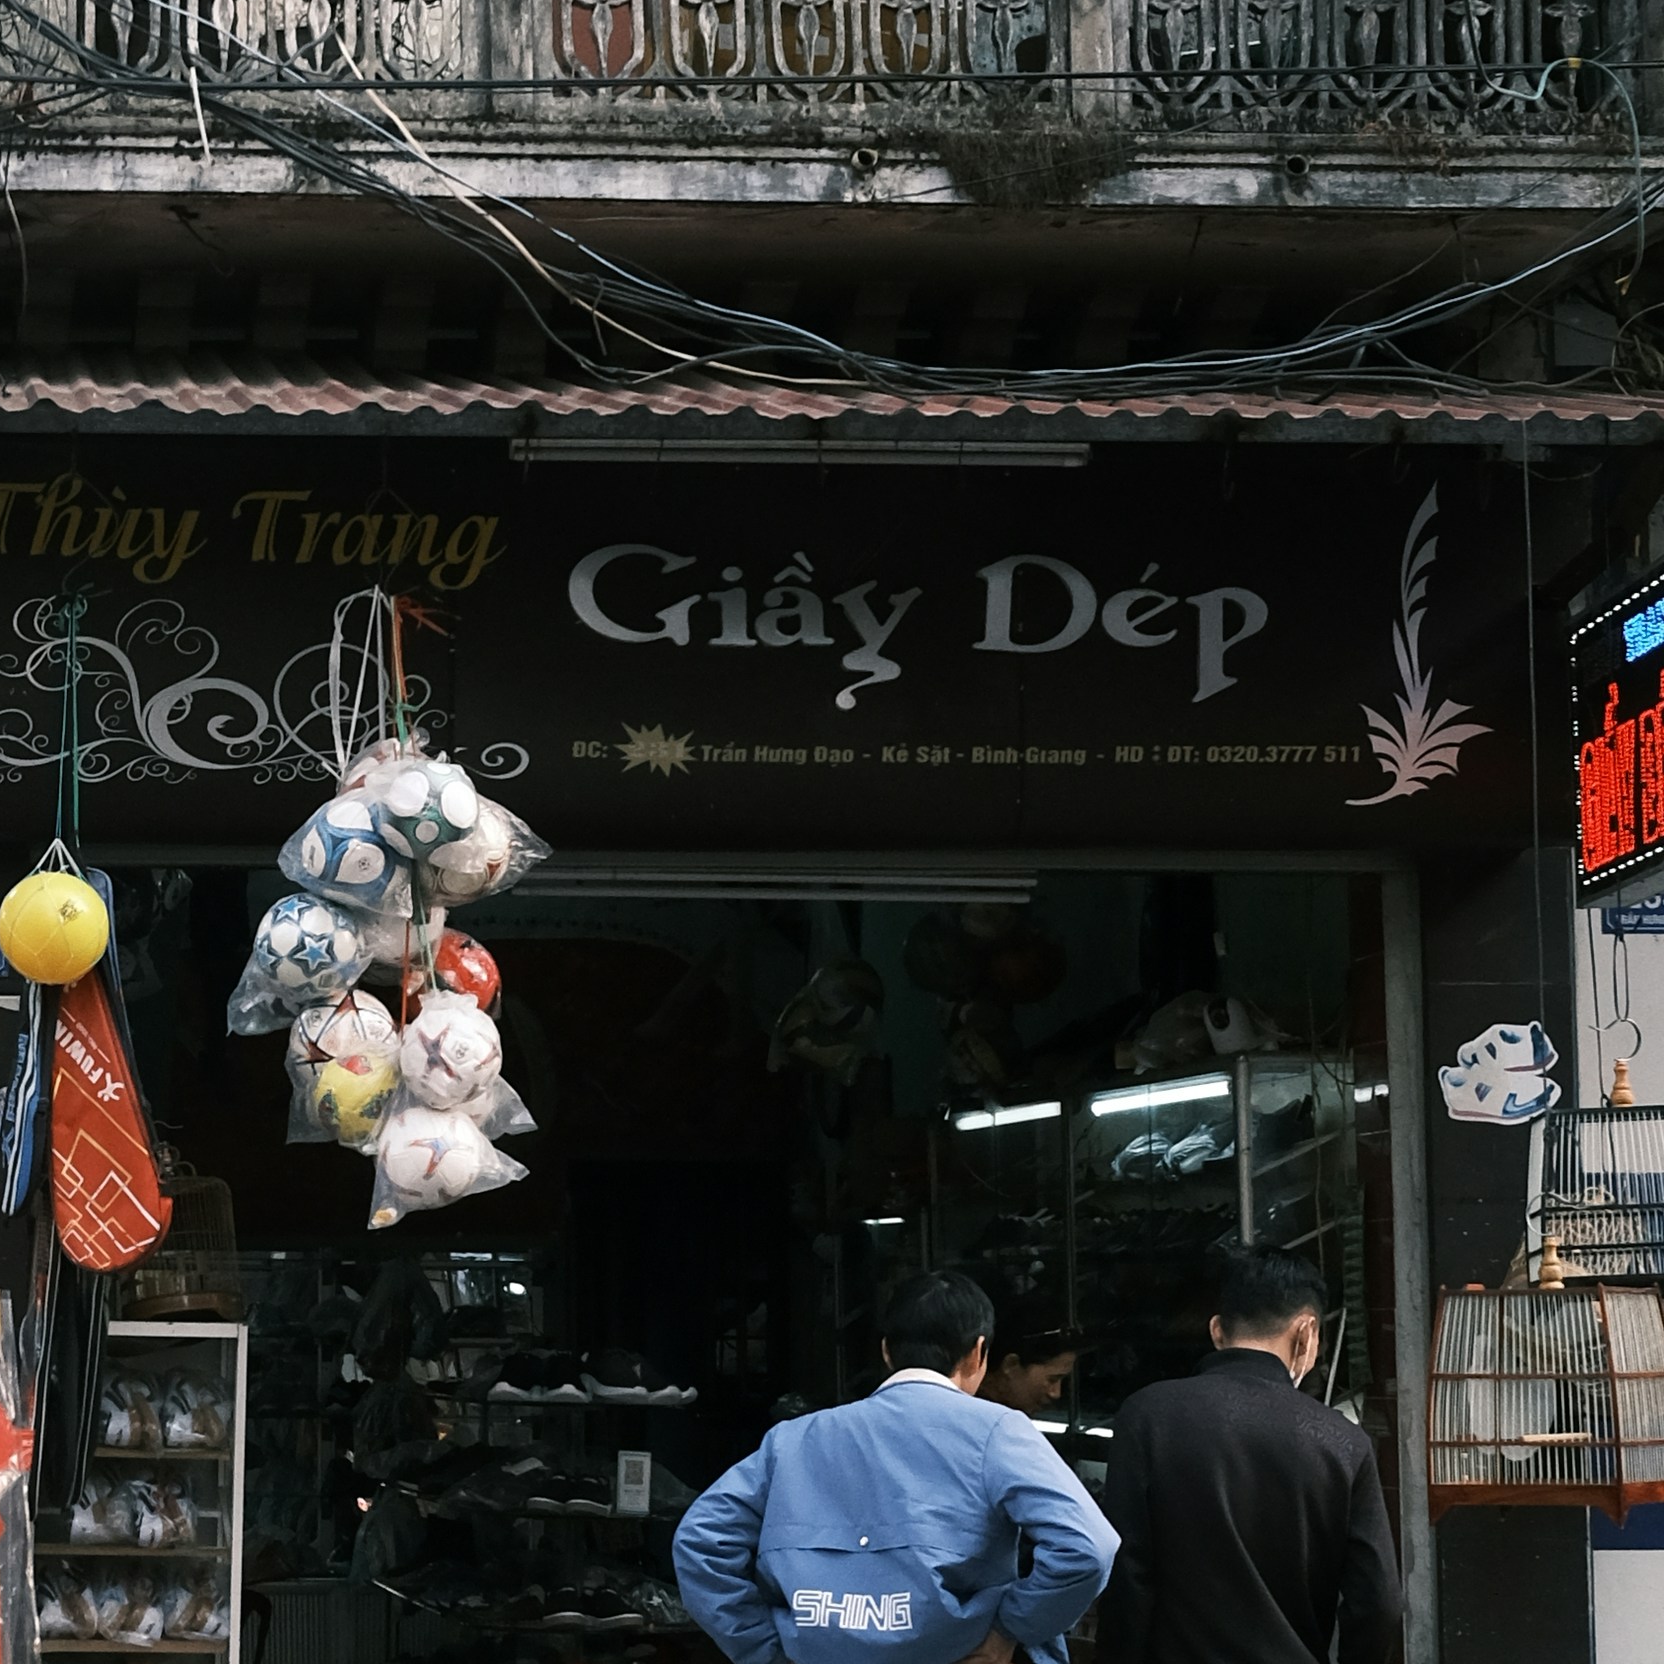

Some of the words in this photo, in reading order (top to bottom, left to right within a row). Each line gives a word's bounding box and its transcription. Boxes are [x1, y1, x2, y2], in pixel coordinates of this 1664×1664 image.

[231, 489, 507, 590] Trang
[567, 544, 922, 710] Giầy
[972, 553, 1268, 702] Dép
[813, 745, 854, 768] Đạo
[1323, 746, 1361, 763] 511
[792, 1589, 913, 1632] SHING
